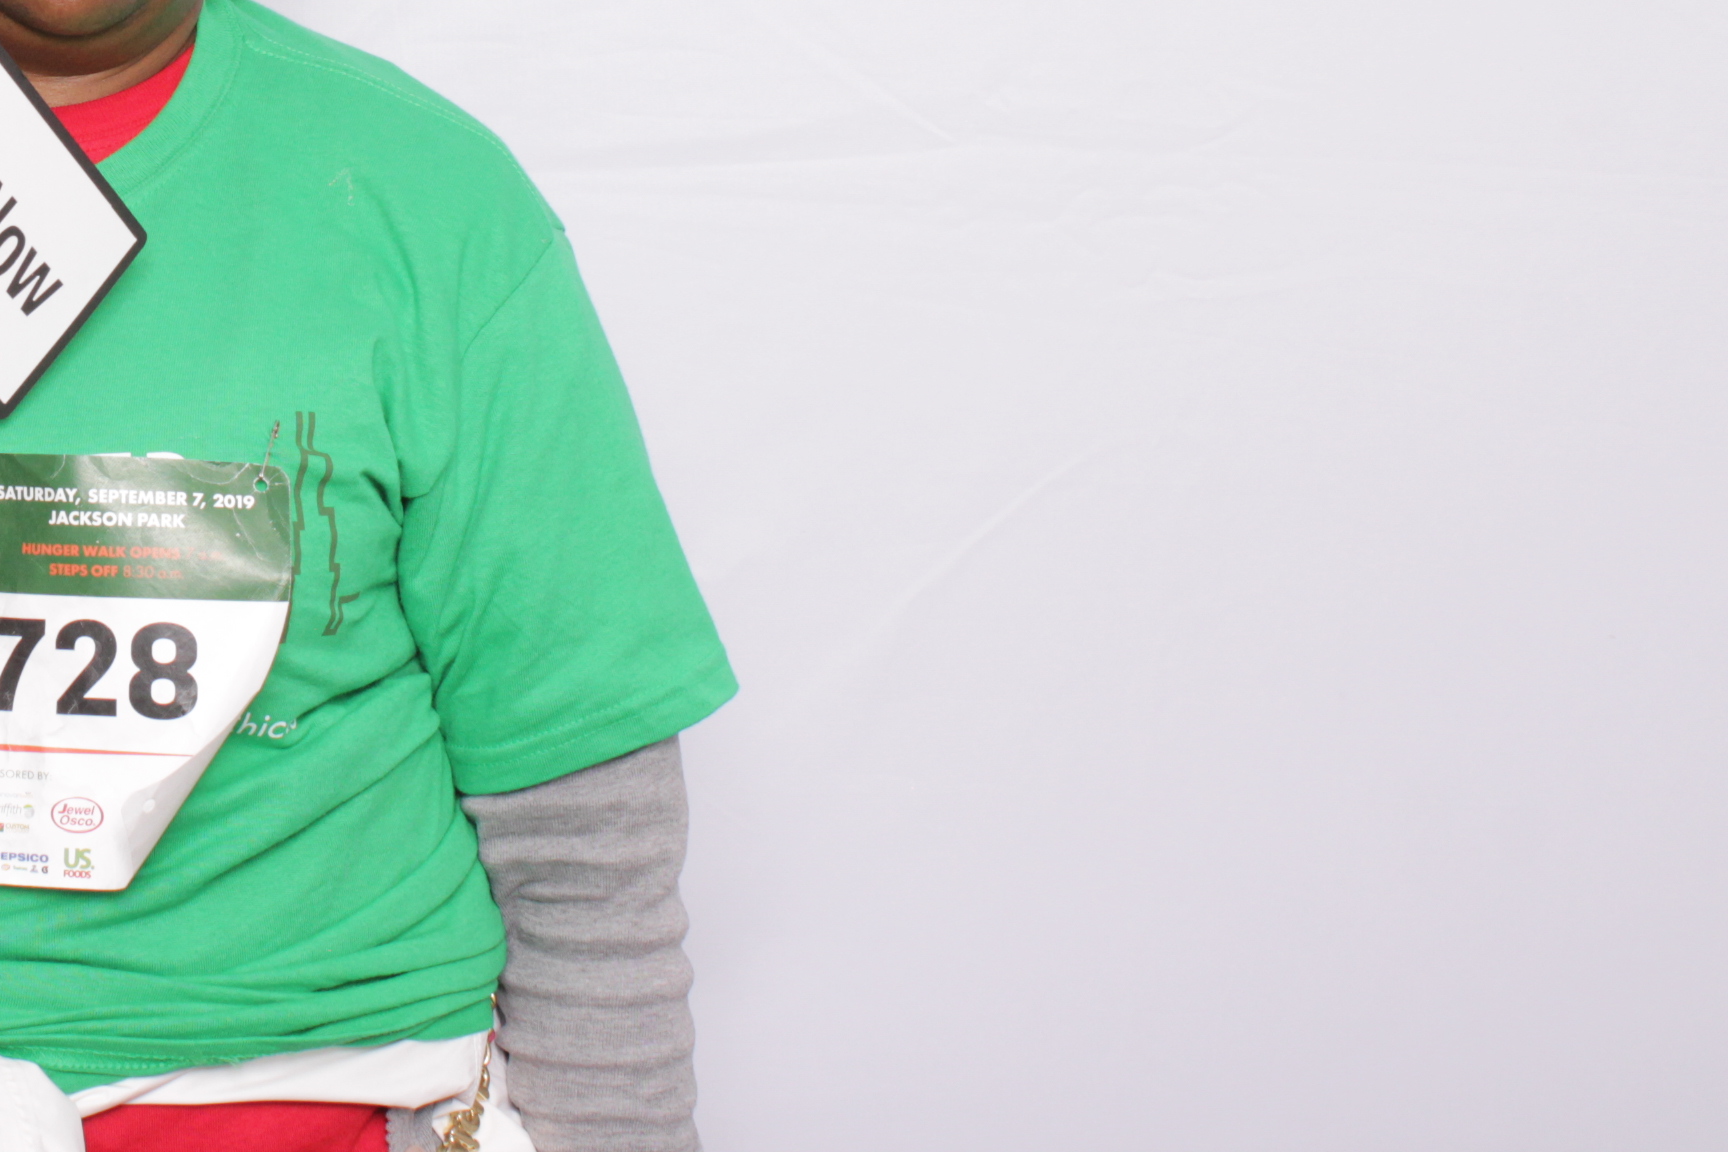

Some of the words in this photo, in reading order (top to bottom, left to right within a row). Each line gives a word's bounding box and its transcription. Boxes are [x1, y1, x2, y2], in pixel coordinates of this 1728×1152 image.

[88, 489, 187, 506] SEPTEMBER
[192, 493, 206, 509] 7,
[213, 495, 255, 509] 2019
[49, 510, 133, 527] JACKSON
[137, 513, 185, 528] PARK
[22, 543, 80, 557] HUNGER
[83, 545, 126, 558] WALK
[130, 546, 180, 560] OPENS
[49, 563, 88, 576] STEPS
[91, 565, 119, 577] OFF
[58, 803, 95, 815] Jewel
[63, 869, 91, 879] FOODS
